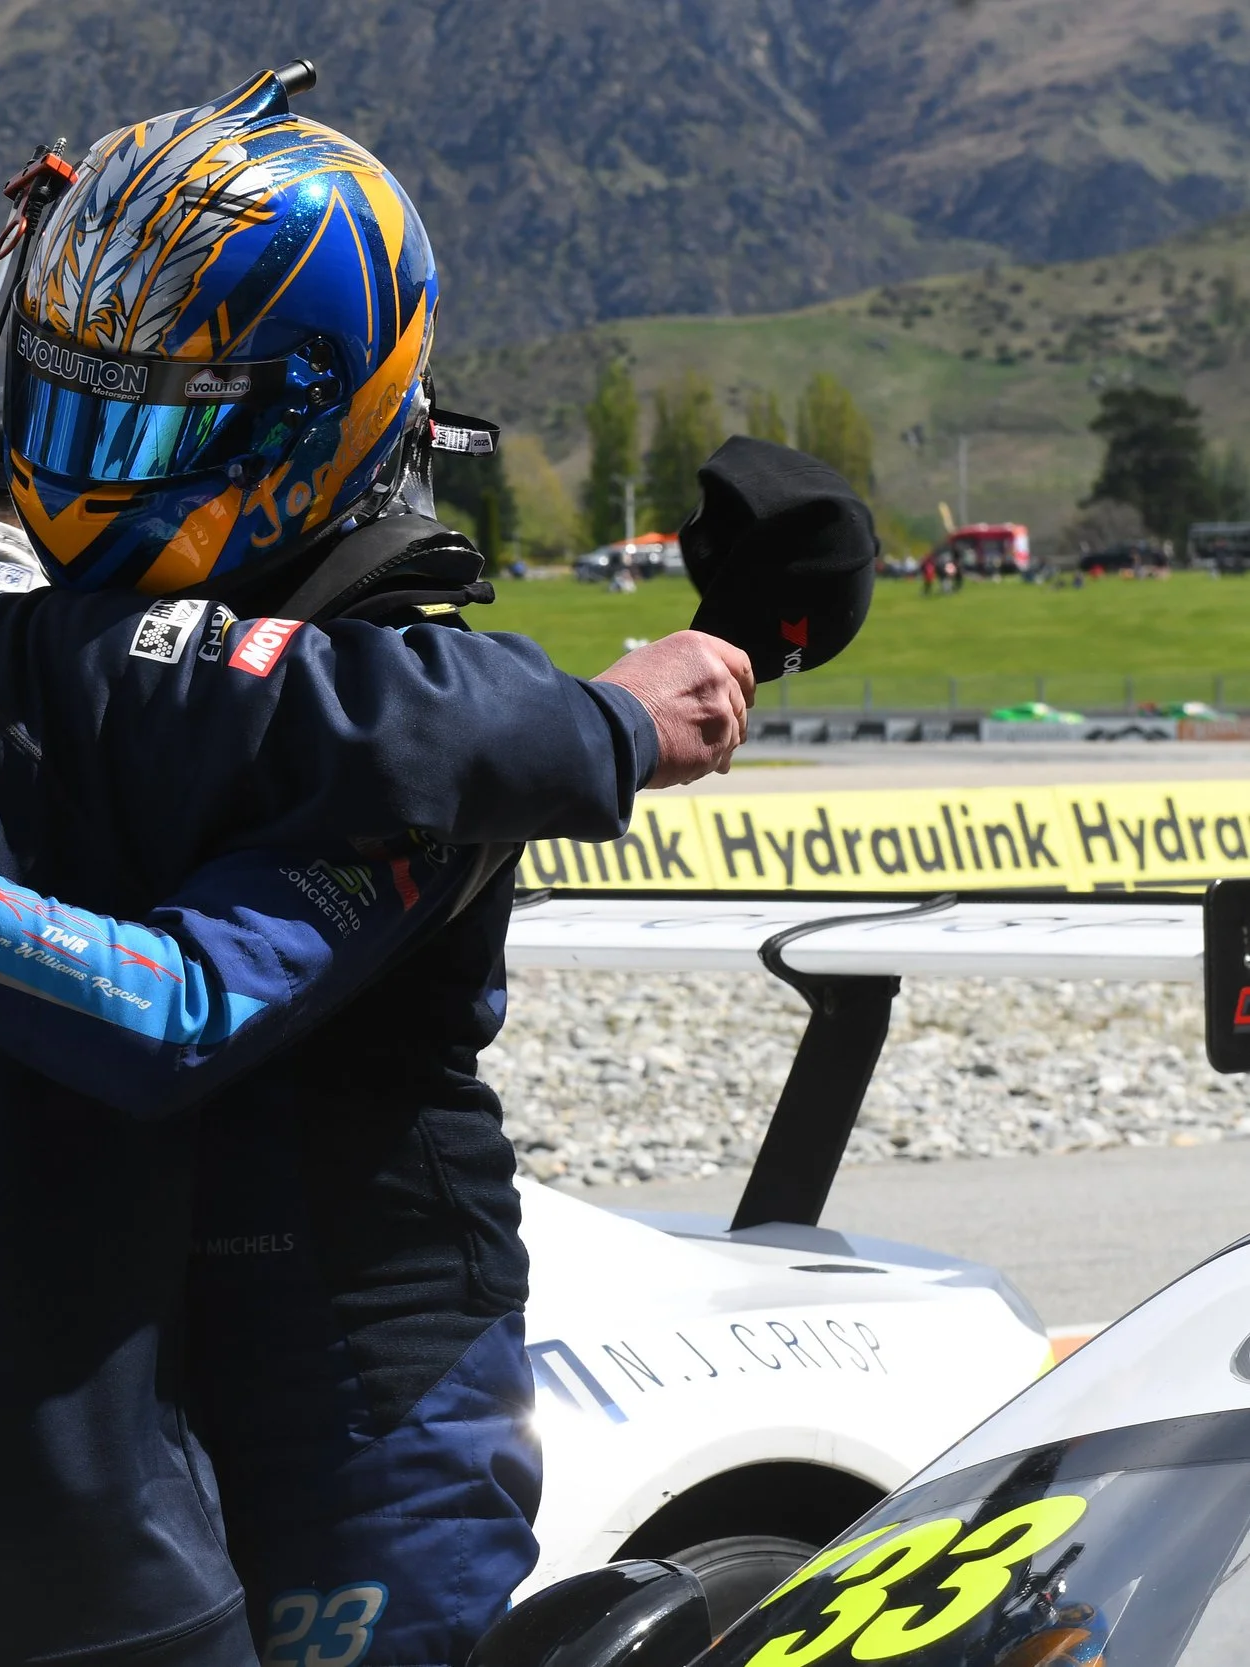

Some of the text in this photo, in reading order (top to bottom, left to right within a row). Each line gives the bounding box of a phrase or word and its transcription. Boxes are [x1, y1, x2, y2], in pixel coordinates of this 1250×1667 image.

[17, 325, 148, 394] EVOLUTION
[91, 386, 141, 401] Motorsport
[186, 376, 250, 393] EVOLUTION
[515, 809, 696, 885] ulink
[712, 801, 1059, 883] Hydraulink
[1070, 797, 1250, 871] Hydra
[306, 868, 361, 931] UTHLAND
[41, 925, 90, 954] TWR
[14, 941, 88, 981] Williams
[92, 975, 152, 1010] Racing
[206, 1232, 295, 1256] MICHELS
[744, 1495, 1087, 1667] 33
[262, 1586, 384, 1667] 23
